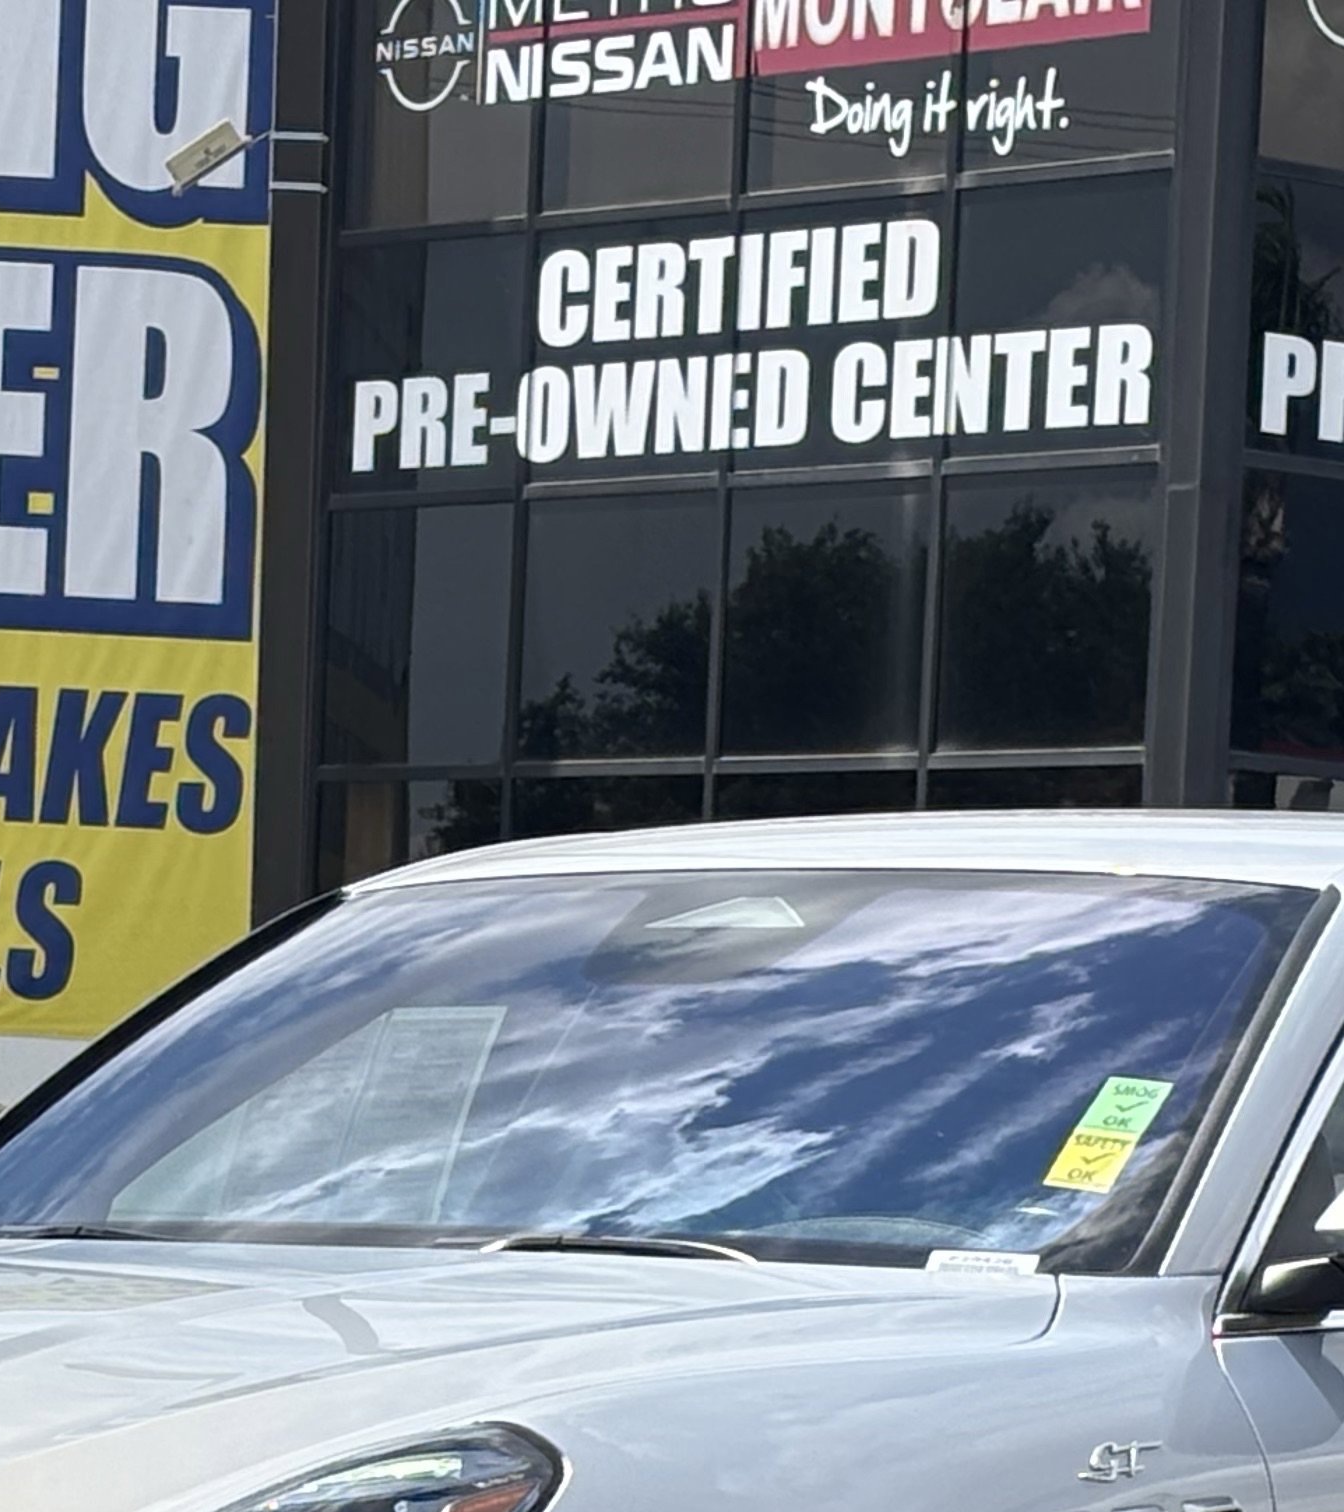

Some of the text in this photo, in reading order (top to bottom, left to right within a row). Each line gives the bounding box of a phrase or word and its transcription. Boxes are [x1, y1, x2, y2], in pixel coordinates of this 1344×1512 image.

[375, 31, 474, 62] NISSAN
[483, 24, 735, 106] NISSAN
[805, 67, 1069, 157] Doing it right.
[536, 219, 942, 348] CERTIFIED
[351, 323, 1155, 473] PRE-OWNED CENTER
[1112, 1083, 1160, 1099] SMOG
[1102, 1115, 1133, 1128] OK
[1066, 1167, 1098, 1182] OK
[1076, 1439, 1164, 1482] GT
